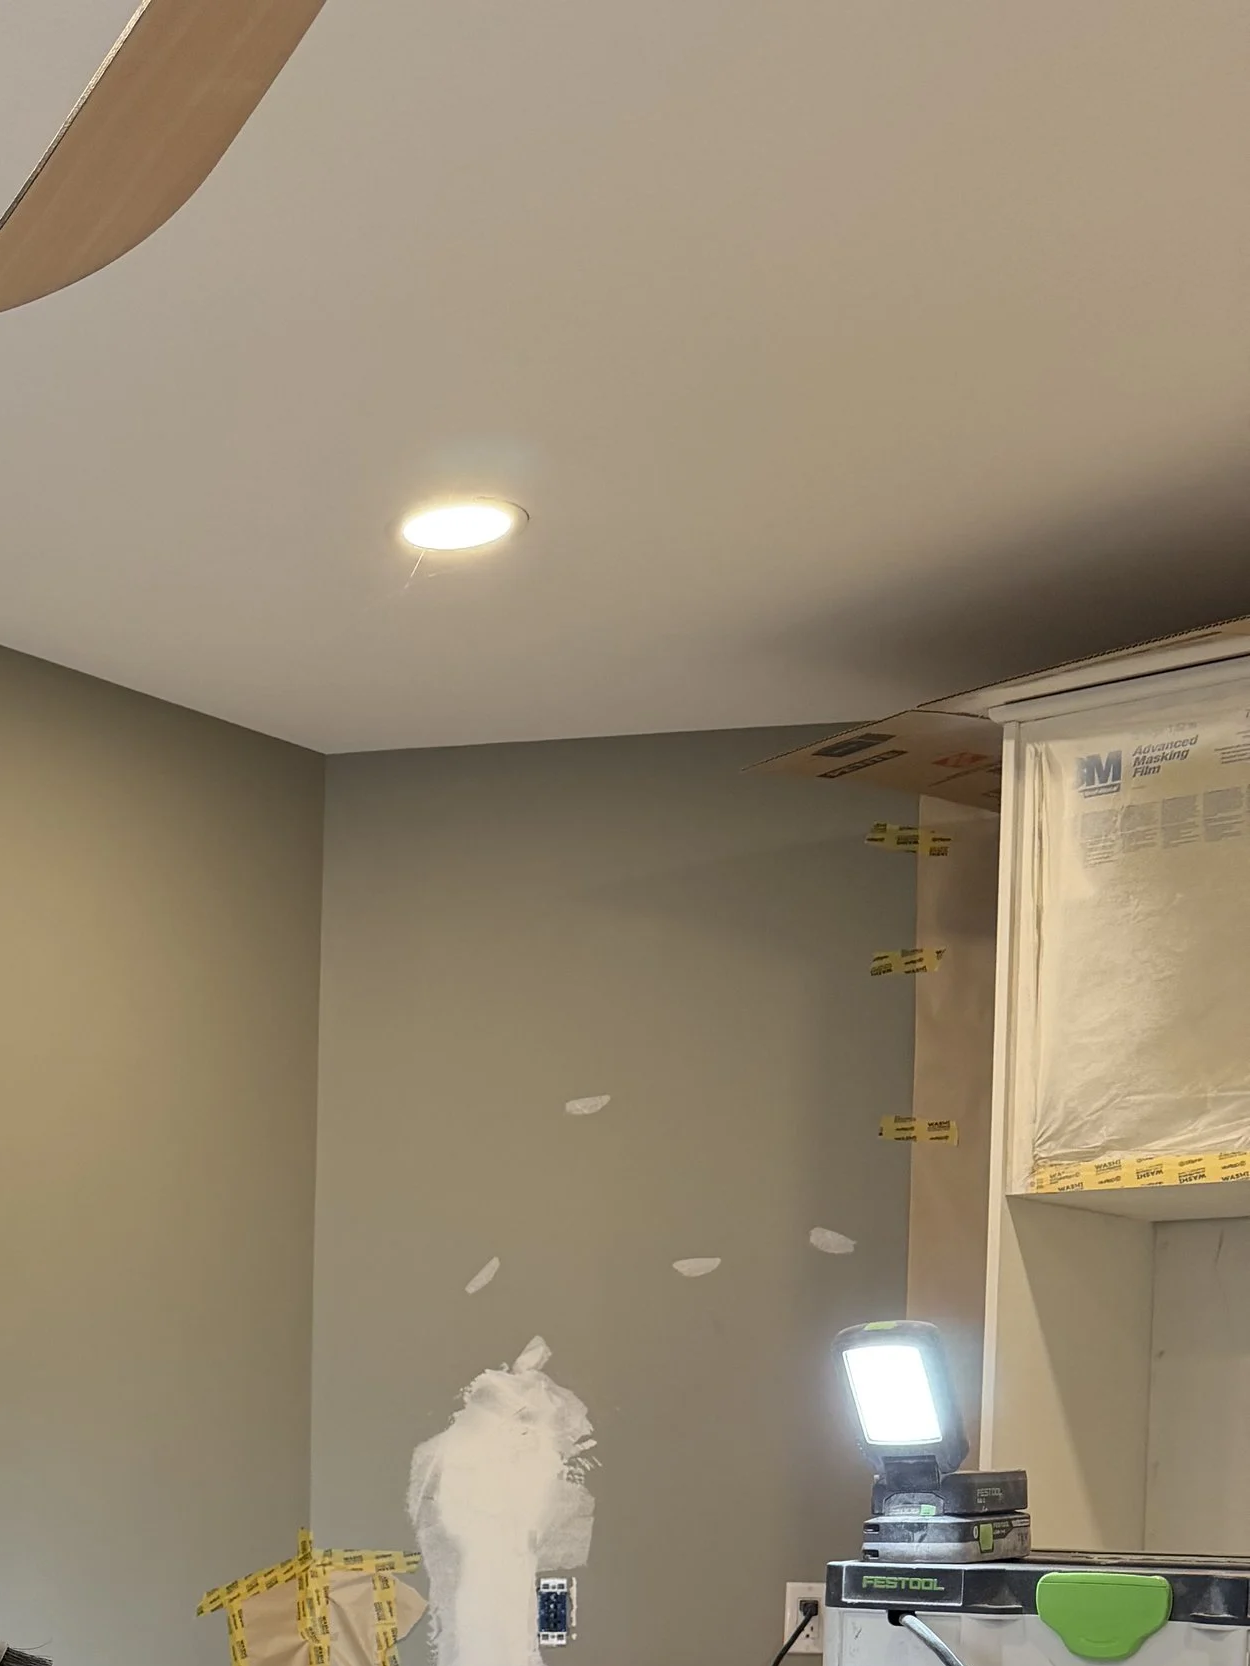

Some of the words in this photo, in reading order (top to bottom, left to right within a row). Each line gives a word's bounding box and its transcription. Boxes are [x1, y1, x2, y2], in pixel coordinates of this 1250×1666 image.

[1132, 735, 1199, 756] Advanced
[1133, 750, 1190, 768] Masking
[1133, 765, 1161, 778] Film
[862, 1575, 945, 1592] FESTOOL
